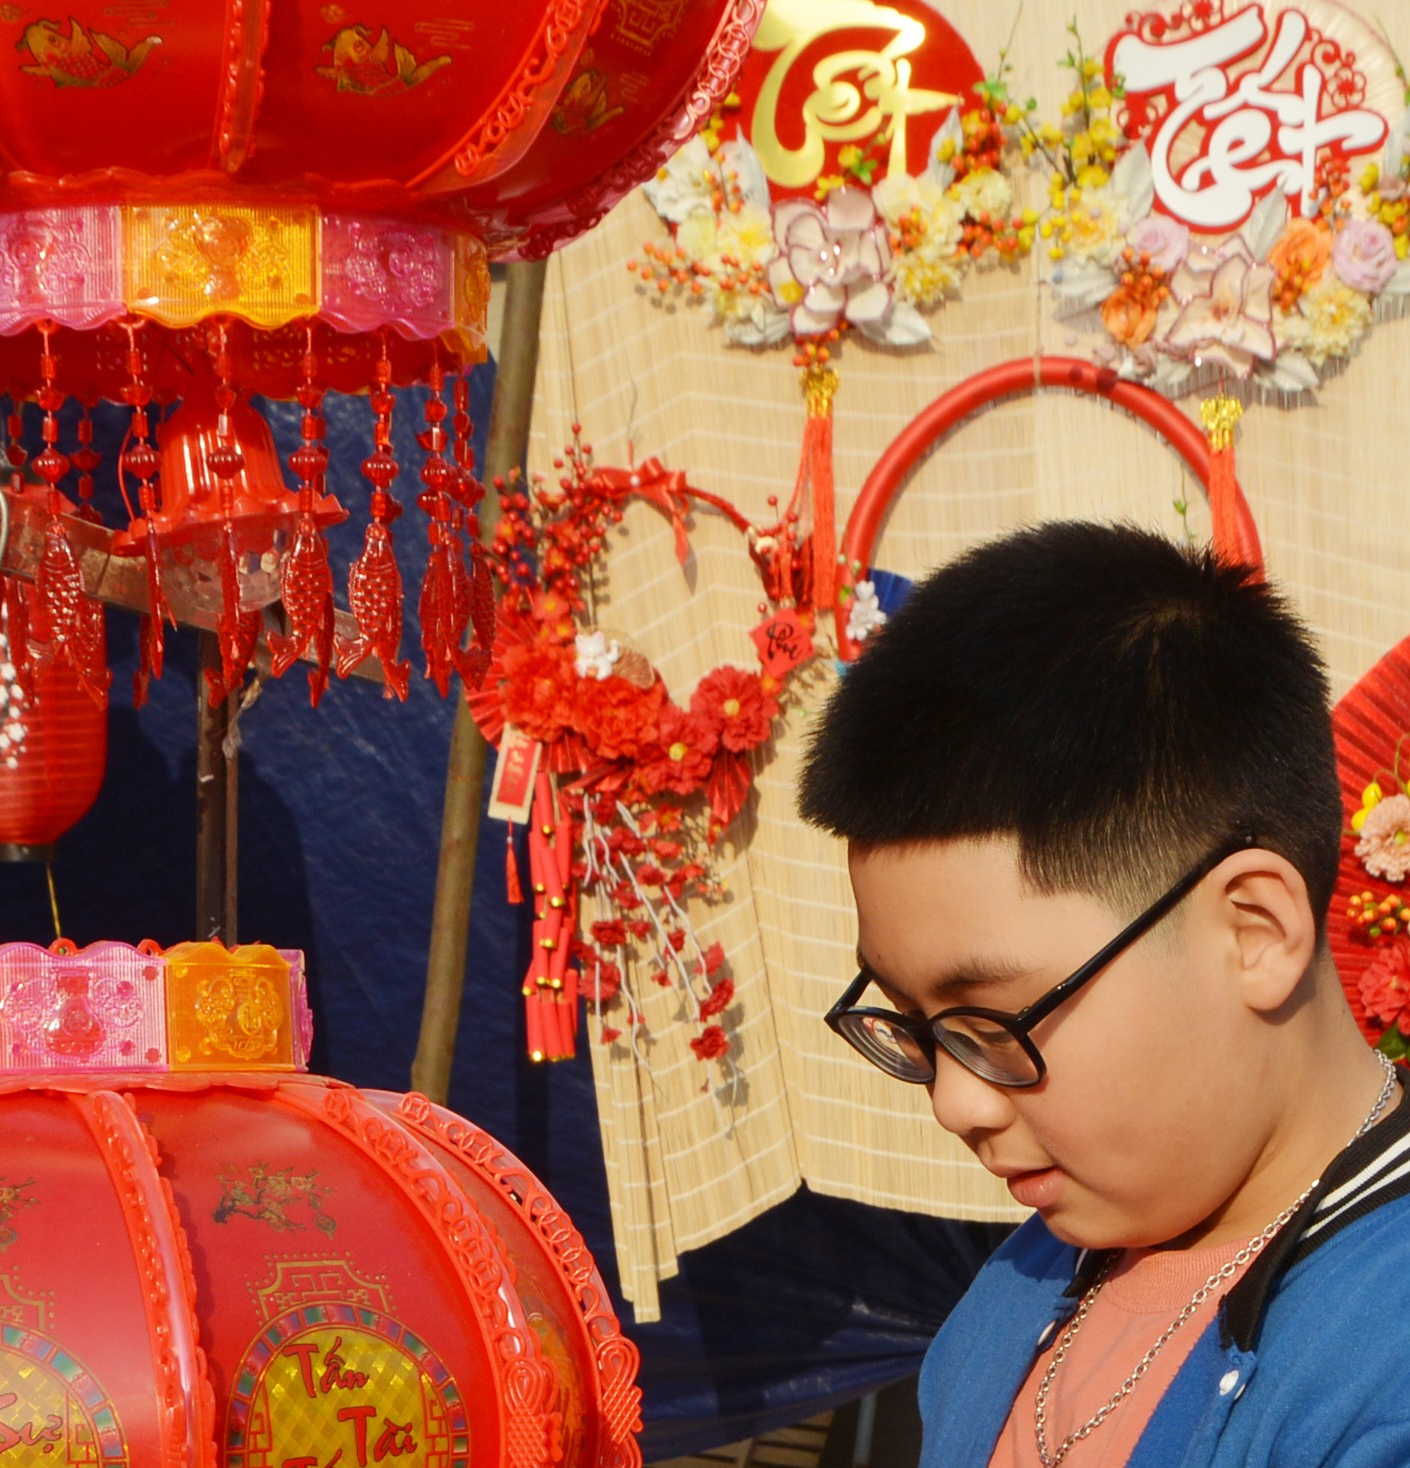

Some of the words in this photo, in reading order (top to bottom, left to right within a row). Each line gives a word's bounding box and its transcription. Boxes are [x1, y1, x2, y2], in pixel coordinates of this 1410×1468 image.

[1108, 2, 1388, 228] Tết
[282, 1336, 370, 1398] Tấn
[337, 1405, 418, 1467] Tài
